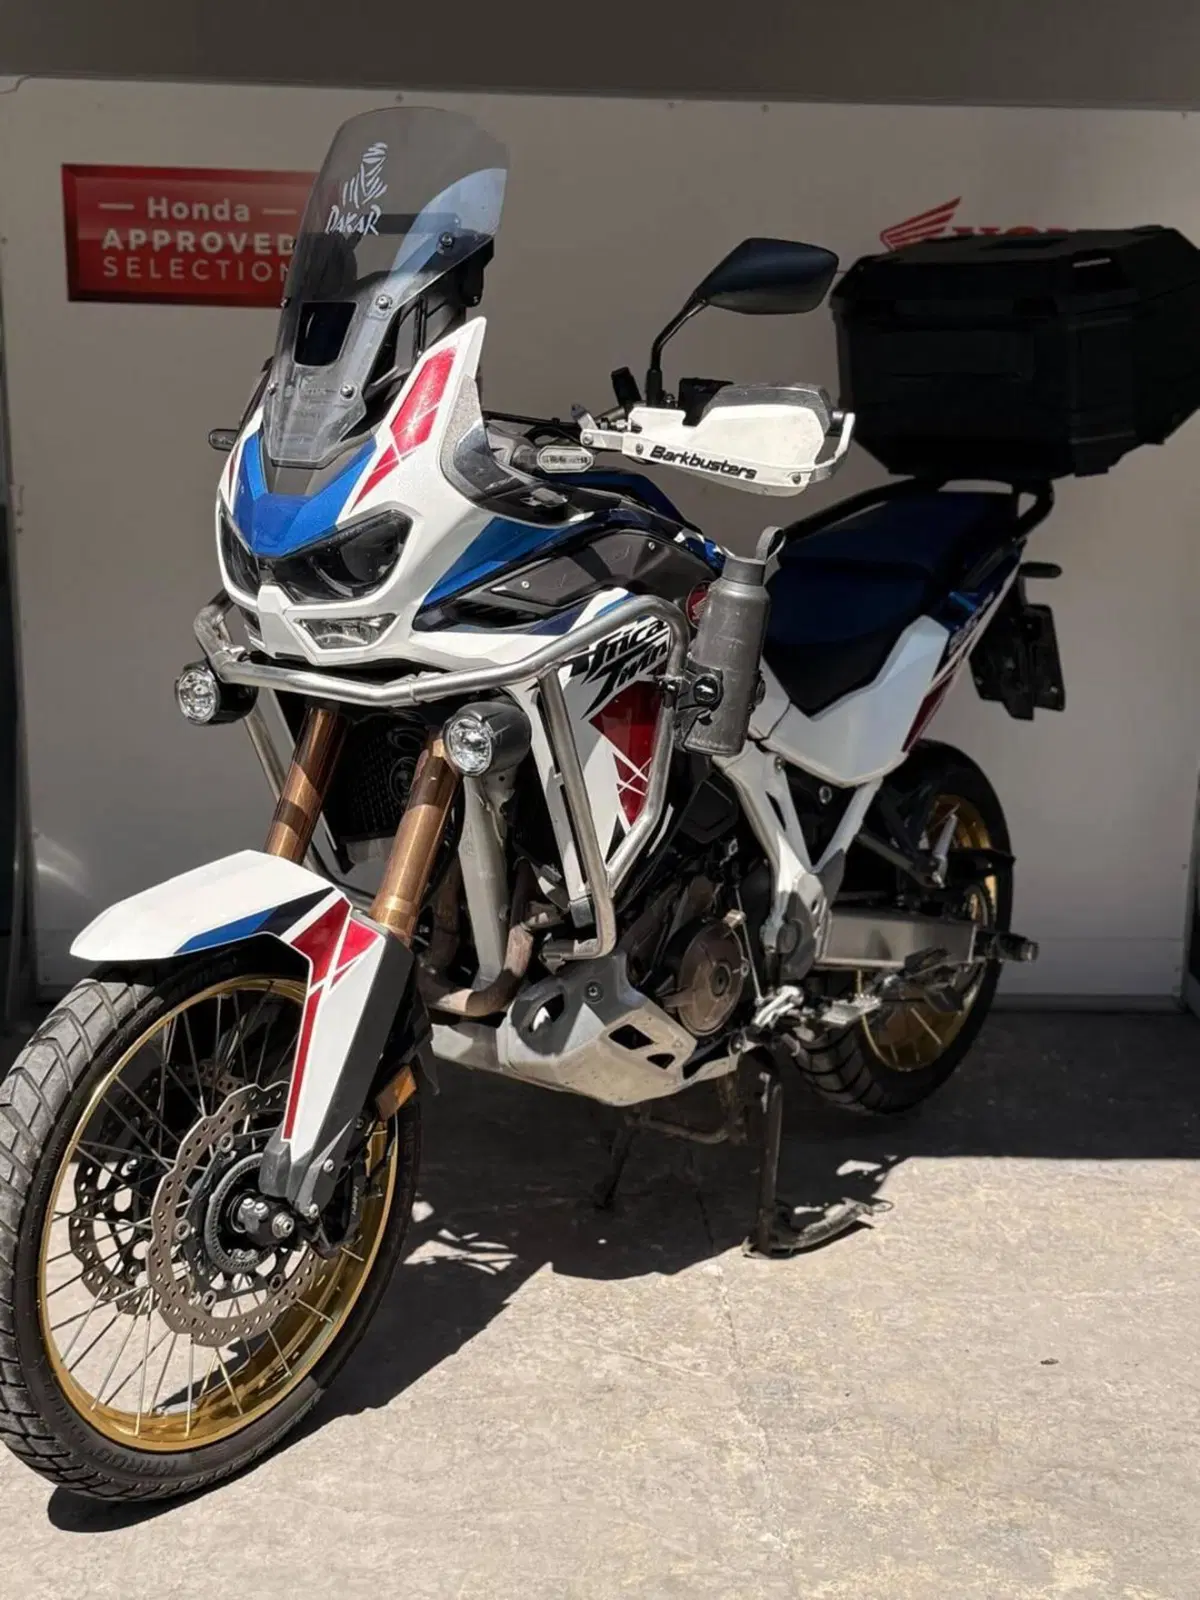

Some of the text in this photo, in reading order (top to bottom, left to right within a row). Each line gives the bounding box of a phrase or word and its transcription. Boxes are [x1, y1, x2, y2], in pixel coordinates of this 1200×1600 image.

[147, 196, 250, 222] Honda
[325, 204, 381, 236] DAKAR
[102, 228, 296, 256] APPROVED
[650, 445, 758, 480] Barkbusters
